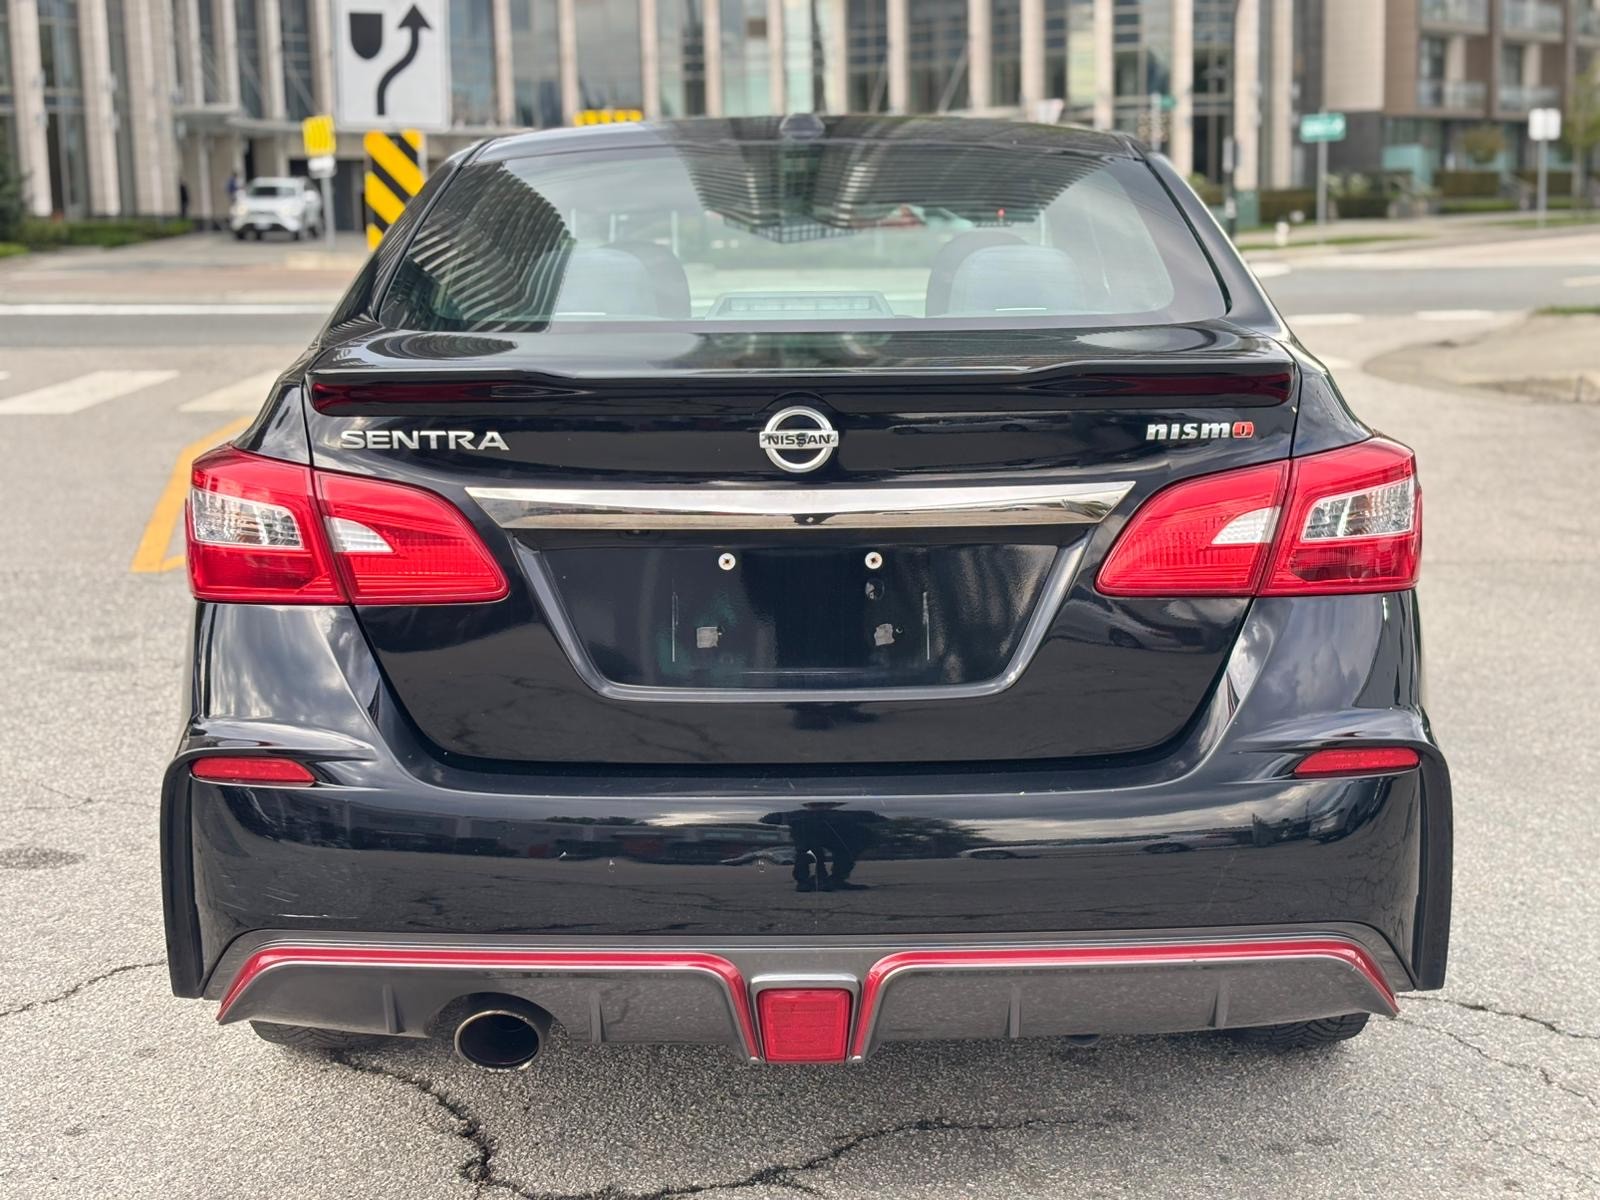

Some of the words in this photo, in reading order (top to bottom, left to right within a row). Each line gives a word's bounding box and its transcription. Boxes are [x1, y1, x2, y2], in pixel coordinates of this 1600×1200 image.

[340, 430, 510, 450] SENTRA
[767, 434, 831, 446] NISSAN
[1145, 421, 1254, 440] nismo
